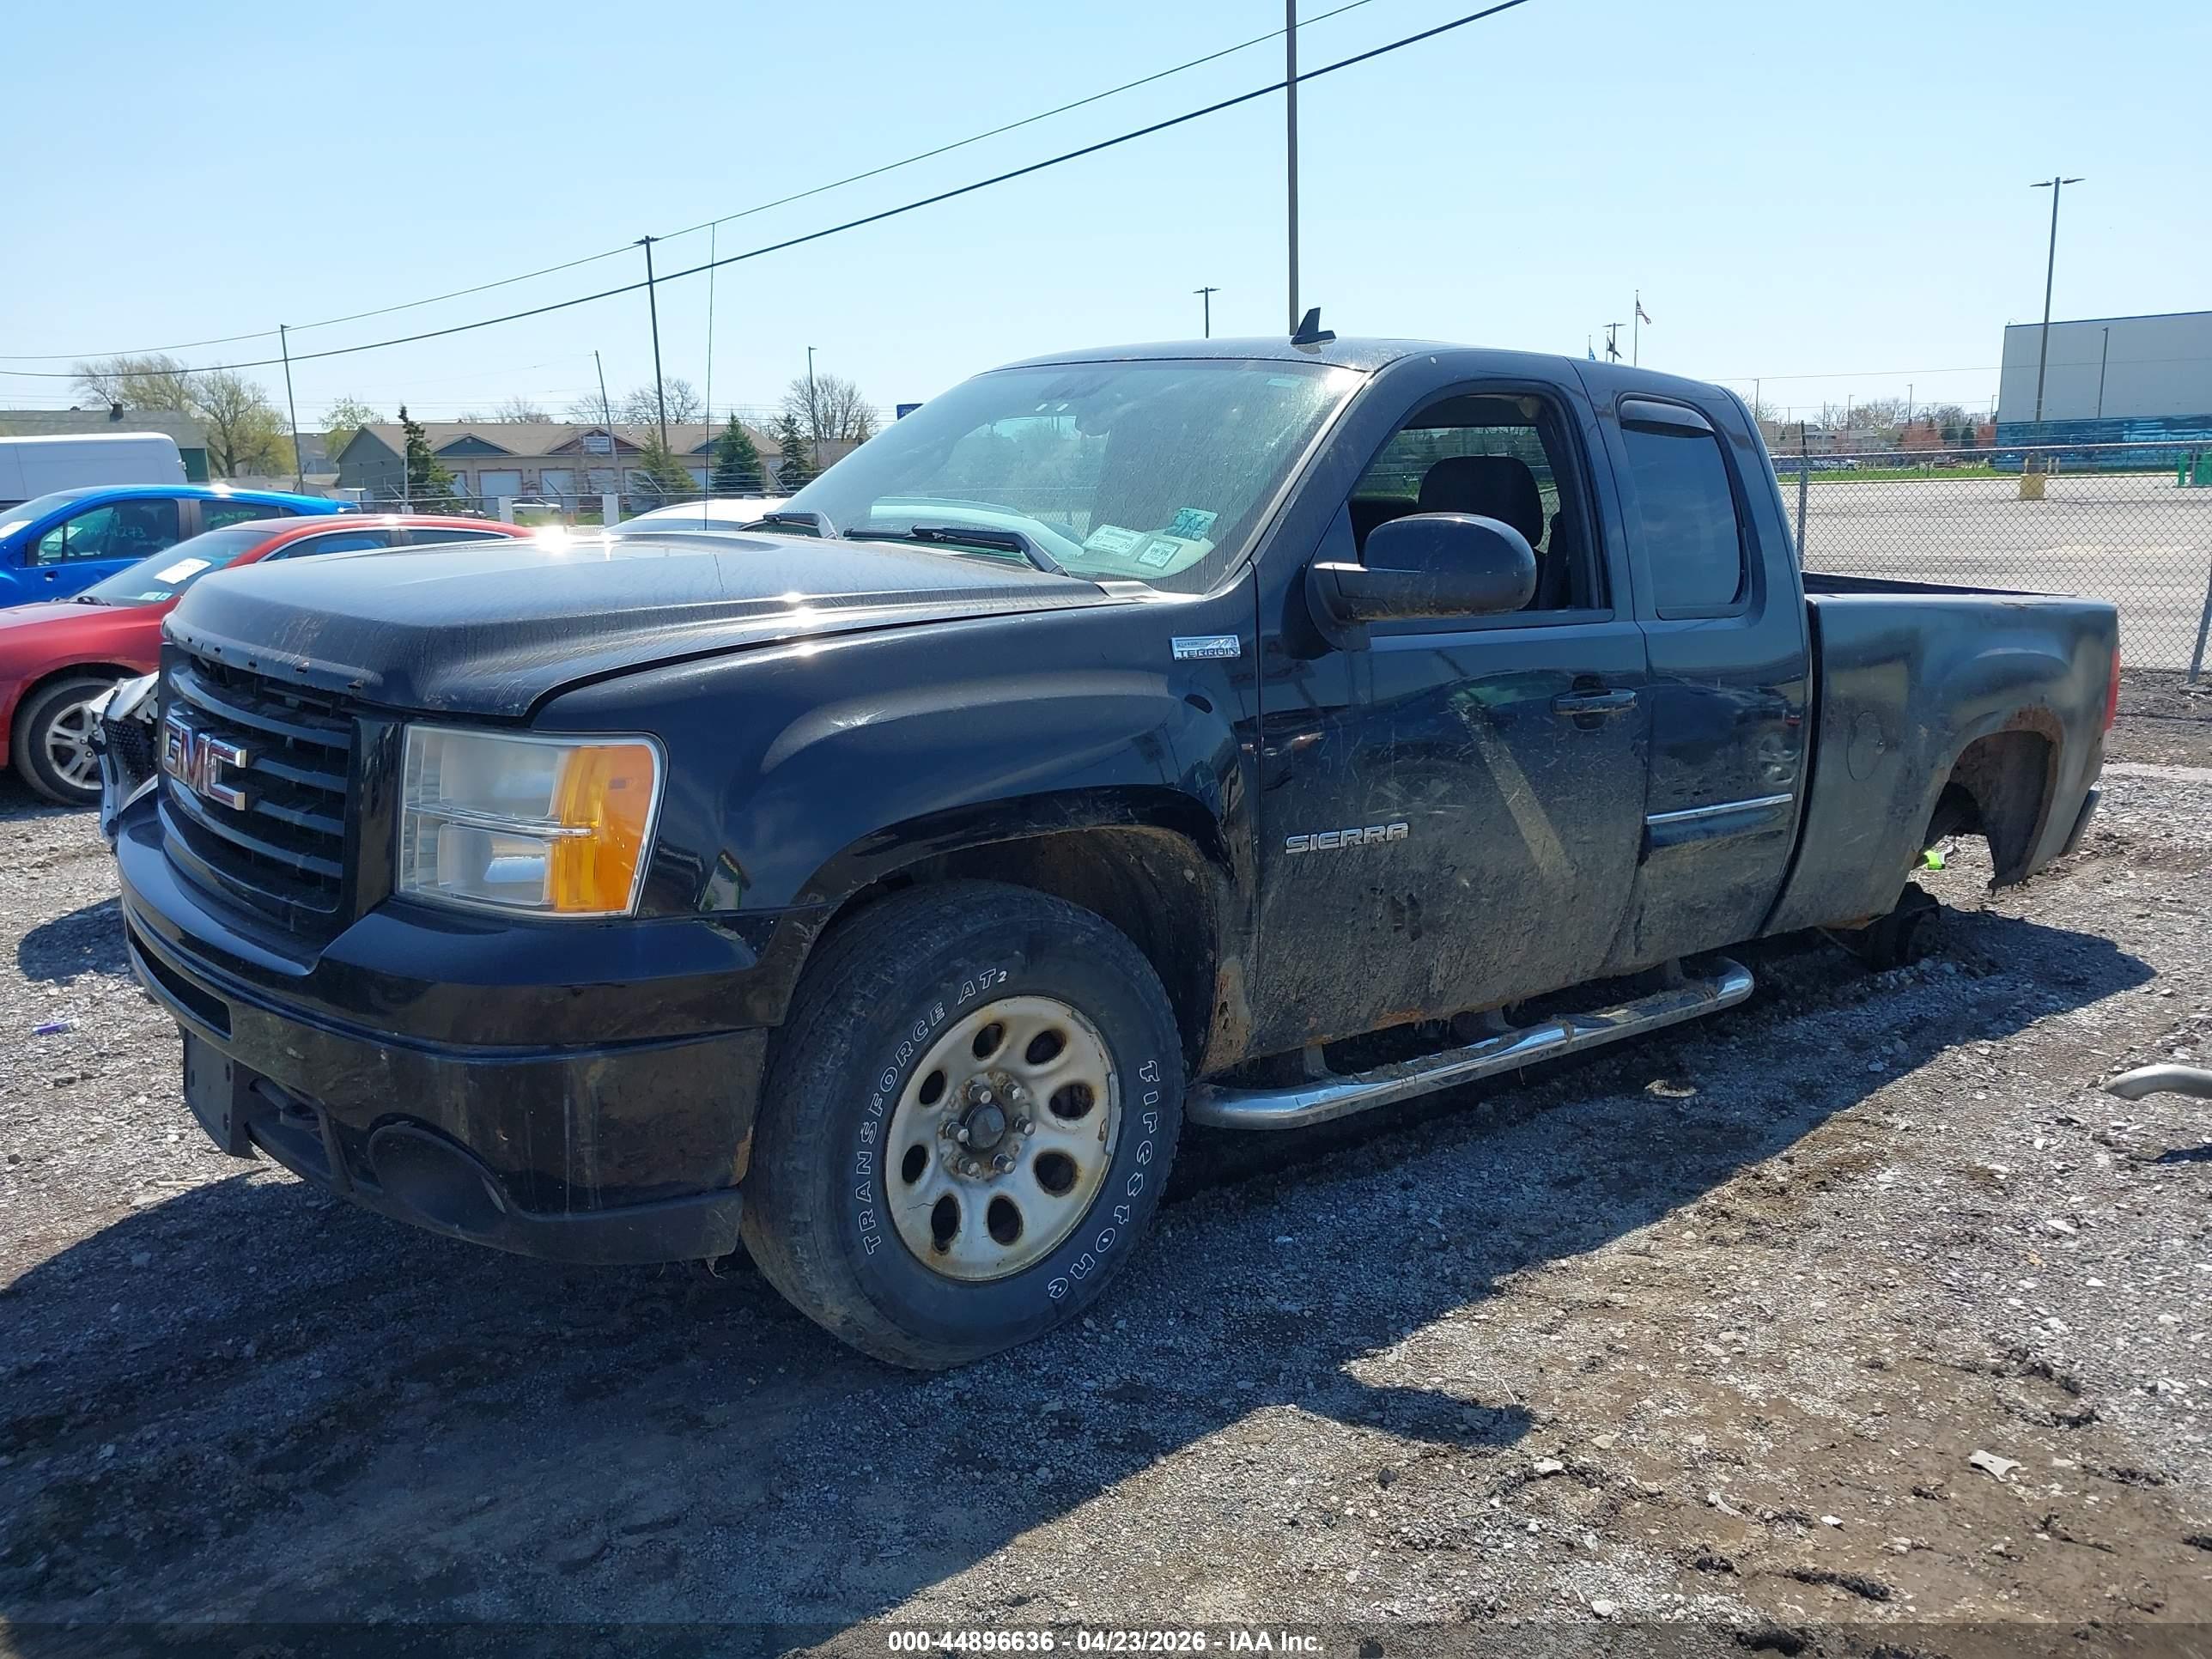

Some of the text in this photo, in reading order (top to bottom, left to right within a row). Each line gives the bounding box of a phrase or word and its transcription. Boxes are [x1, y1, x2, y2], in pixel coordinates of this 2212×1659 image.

[1177, 647, 1240, 659] TERRAIN
[162, 715, 247, 811] GMC
[1285, 822, 1409, 854] SIERRA
[856, 1001, 946, 1255] TRANSFORCE
[1047, 1060, 1160, 1298] Firestone
